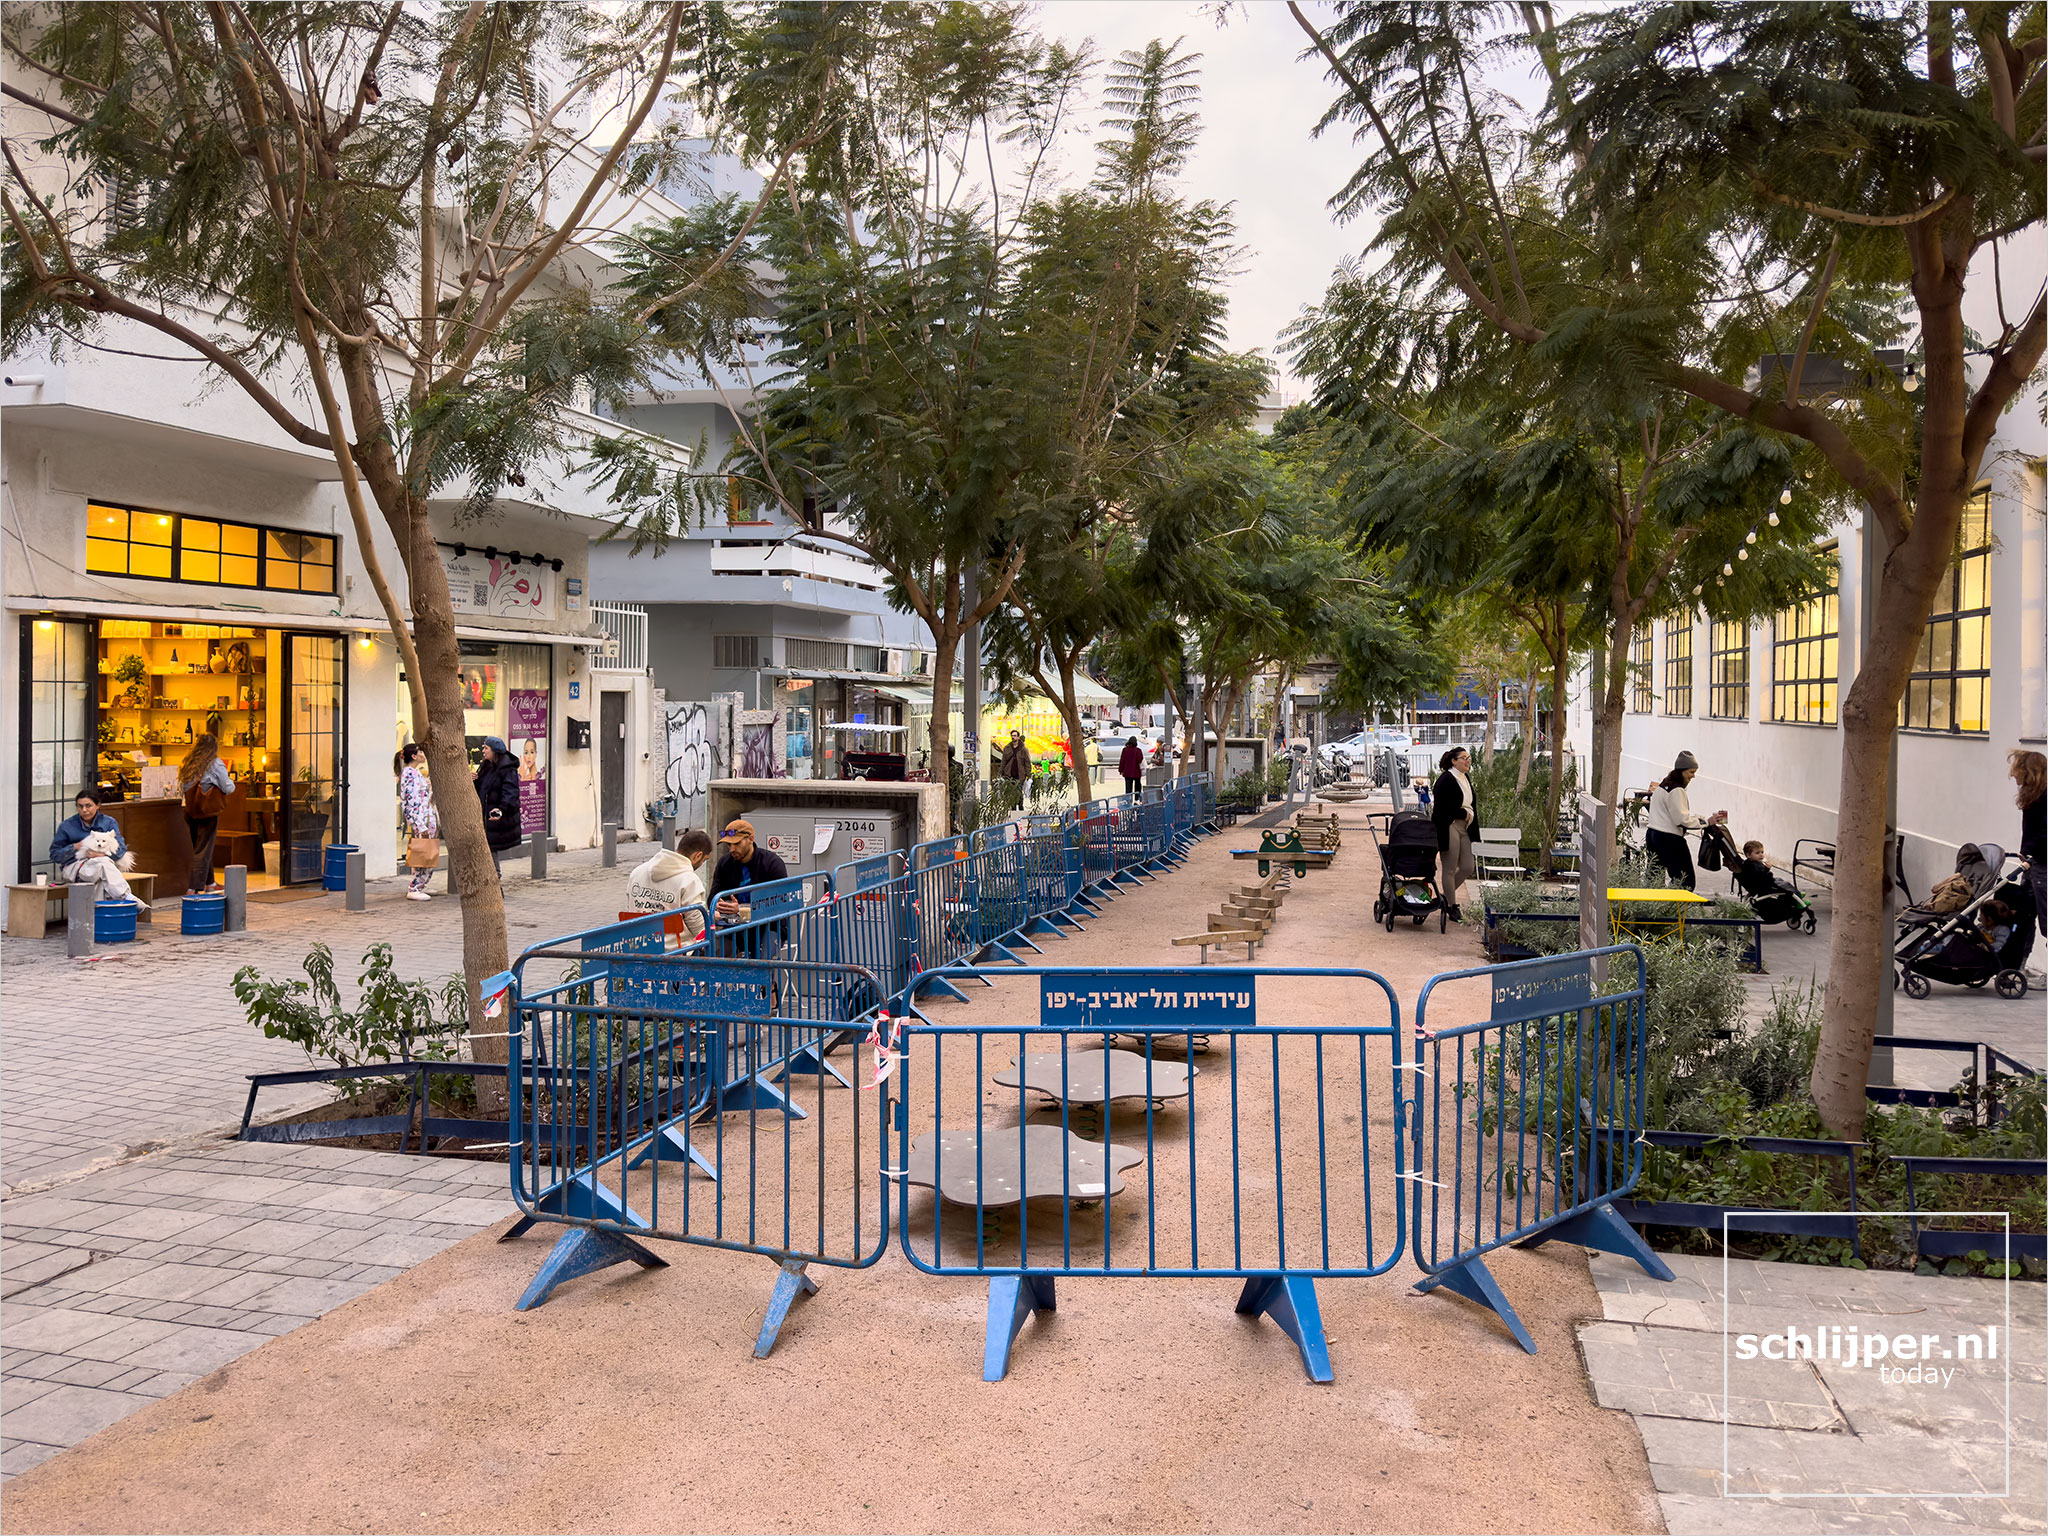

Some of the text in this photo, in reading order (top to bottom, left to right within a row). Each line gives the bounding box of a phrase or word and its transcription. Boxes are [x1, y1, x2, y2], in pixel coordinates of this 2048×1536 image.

[569, 686, 579, 696] 42
[836, 821, 875, 832] 22040
[631, 882, 675, 904] CUPHEAD
[1183, 991, 1250, 1009] עיריית
